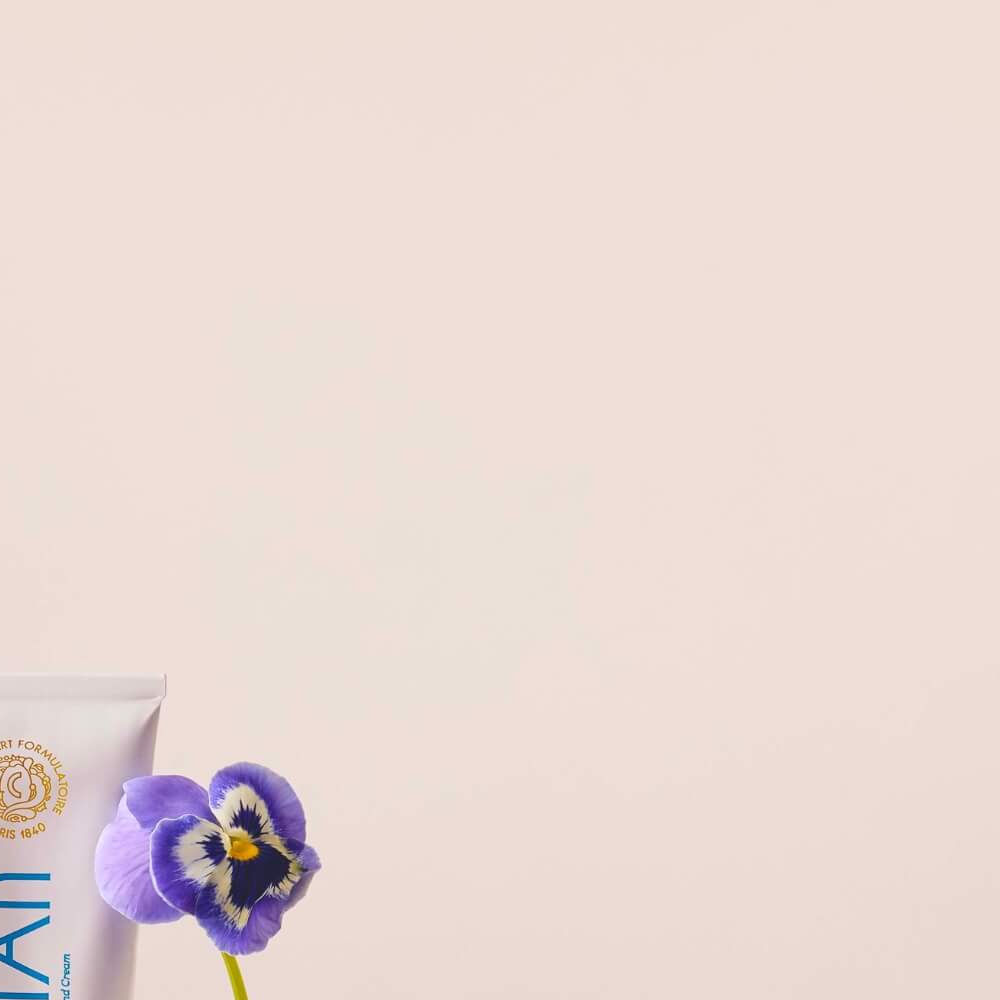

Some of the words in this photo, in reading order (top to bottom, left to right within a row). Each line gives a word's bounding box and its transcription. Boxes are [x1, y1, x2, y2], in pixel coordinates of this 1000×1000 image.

[18, 739, 68, 815] FORMULATOIRE
[21, 822, 46, 839] 1840
[61, 953, 71, 987] Cream
